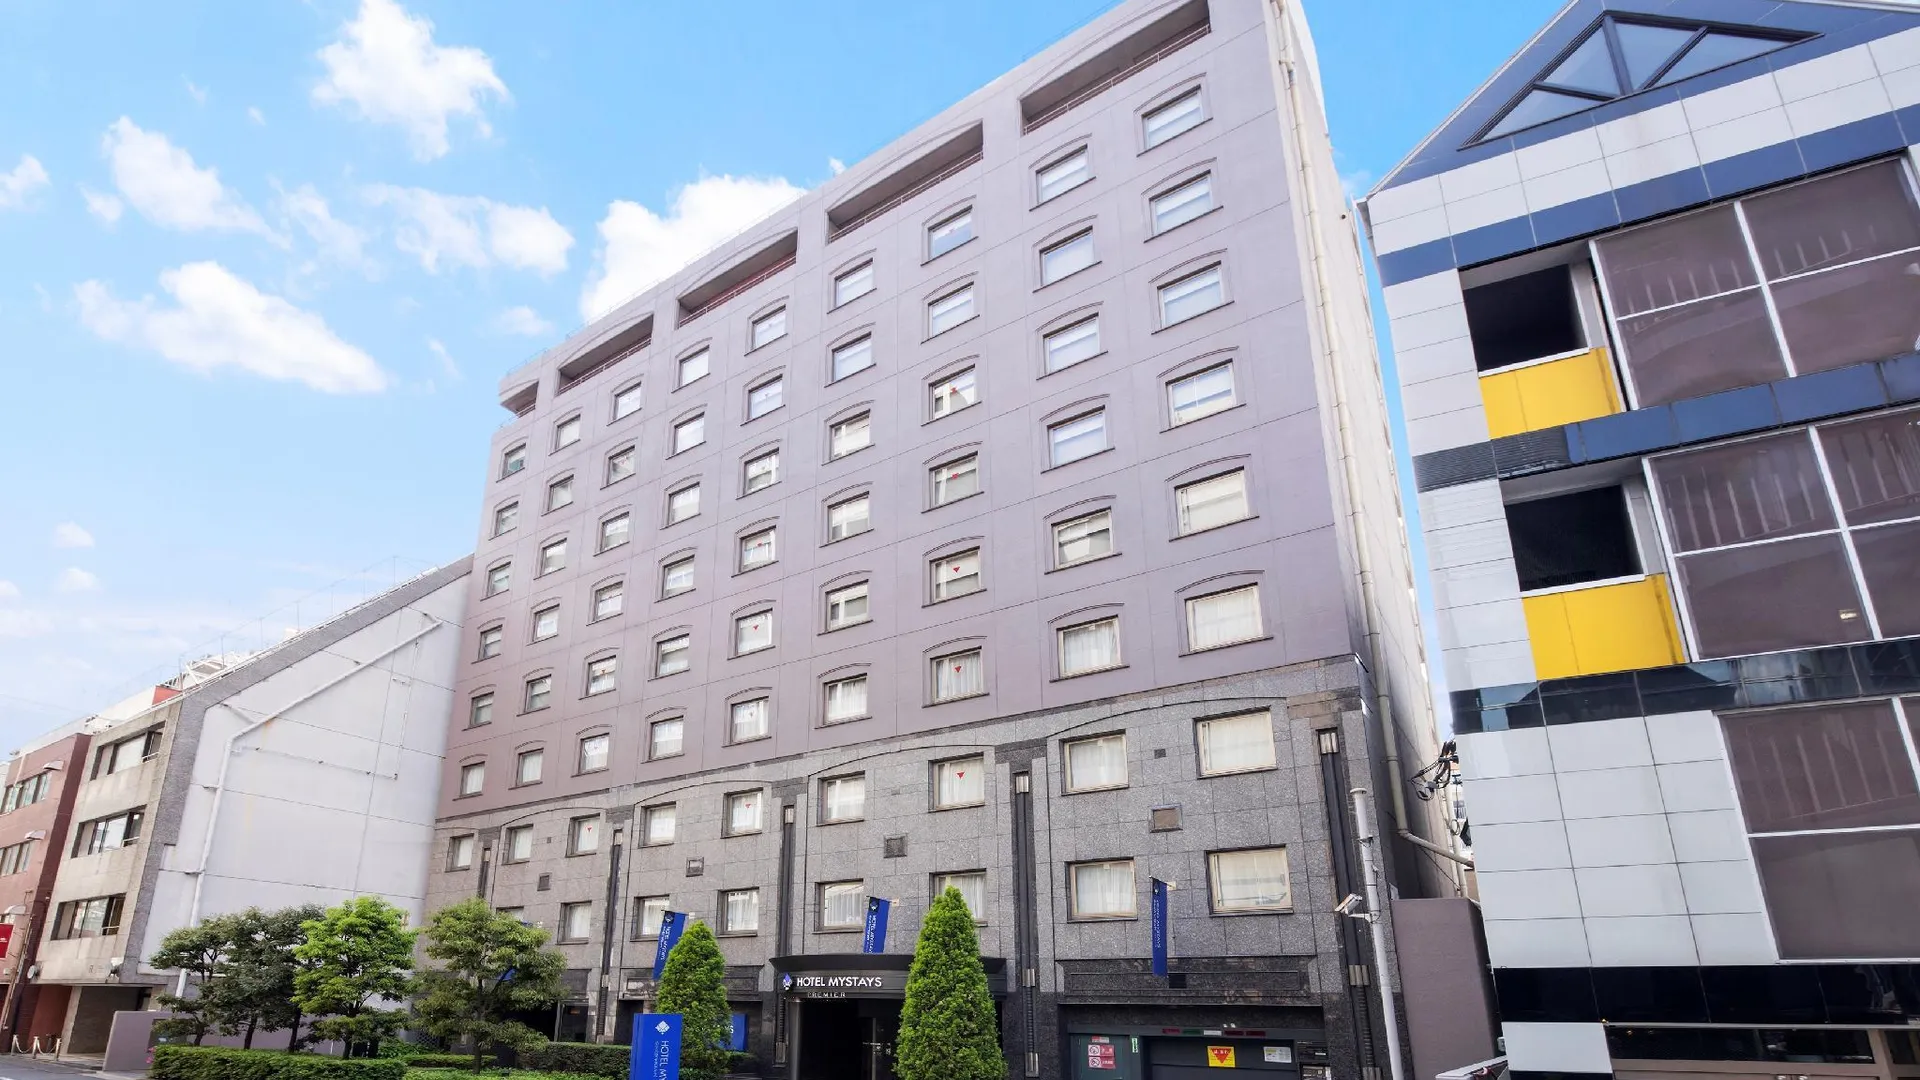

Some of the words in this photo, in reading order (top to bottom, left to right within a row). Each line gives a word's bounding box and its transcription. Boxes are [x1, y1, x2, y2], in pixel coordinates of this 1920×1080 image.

[796, 976, 825, 987] HOTEL
[828, 976, 882, 987] MYSTAYS
[660, 1040, 669, 1067] HOTEL
